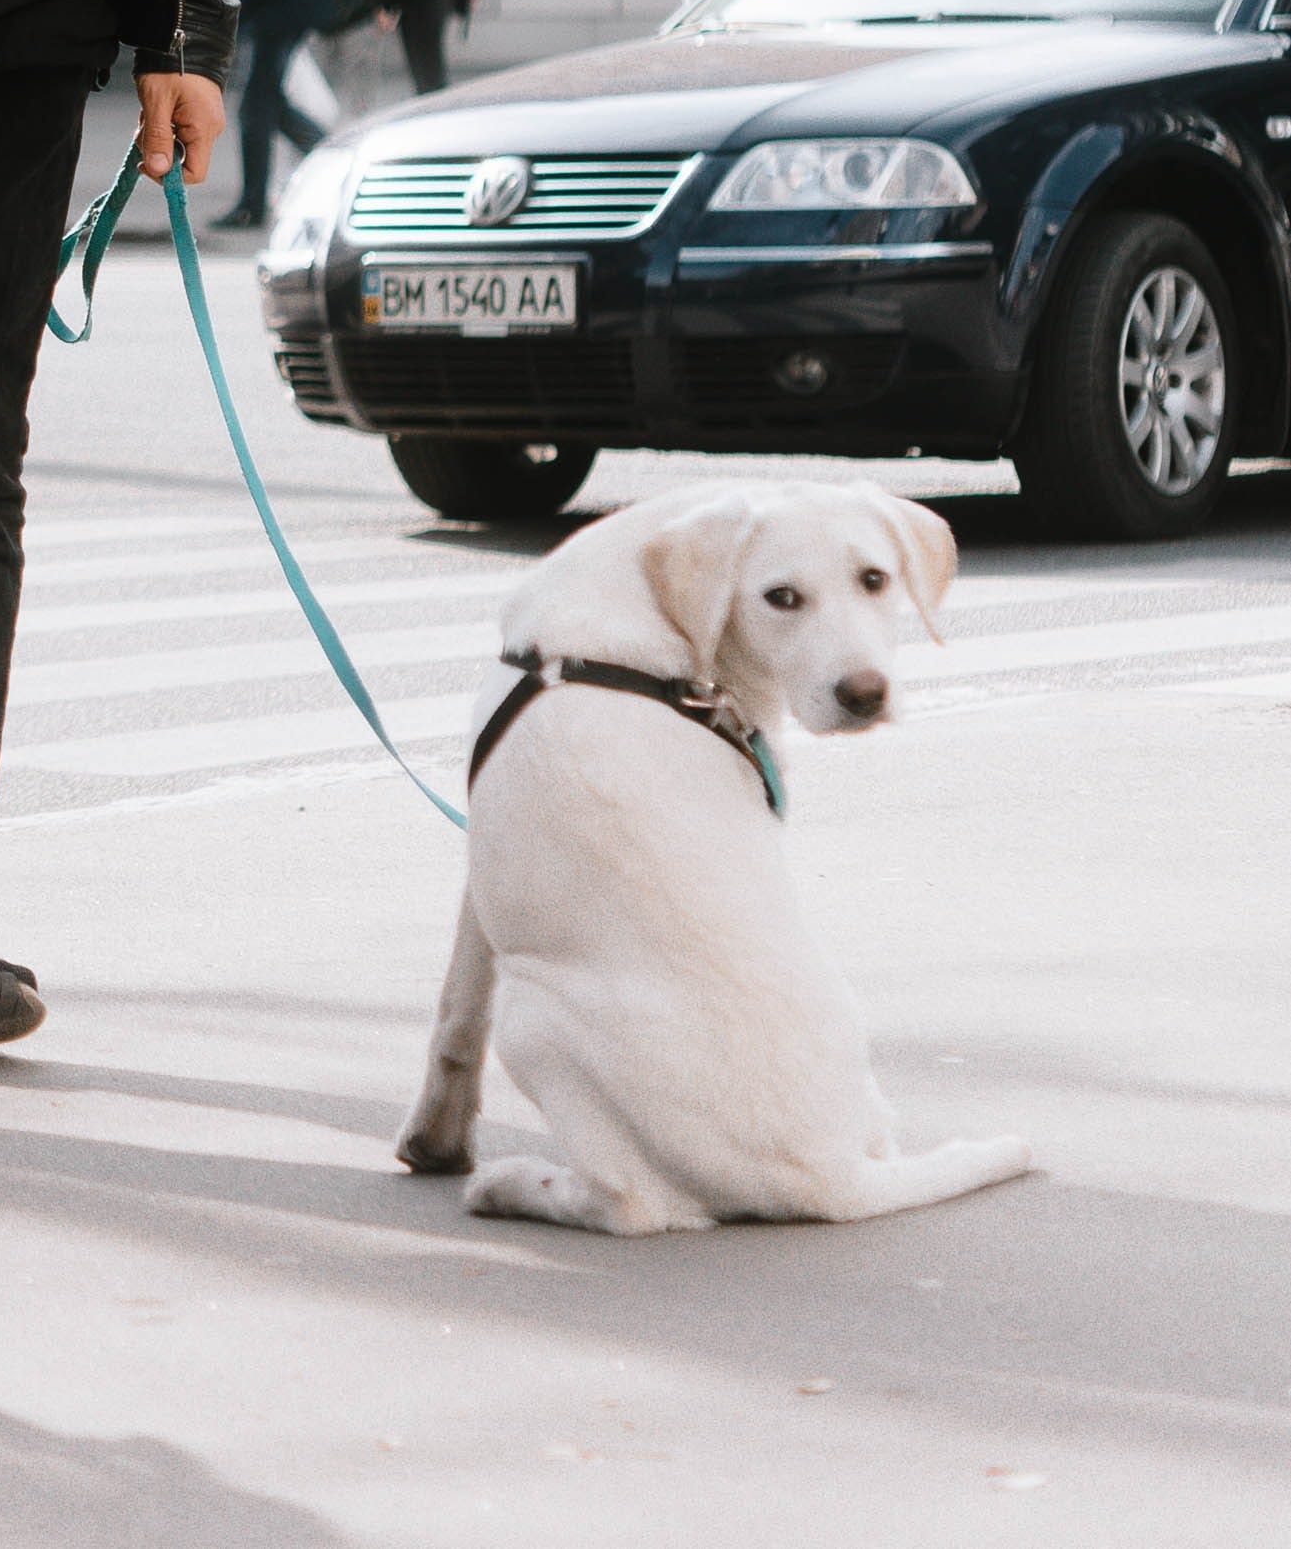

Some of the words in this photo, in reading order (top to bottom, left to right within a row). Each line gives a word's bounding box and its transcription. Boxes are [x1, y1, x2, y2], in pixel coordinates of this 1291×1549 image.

[383, 276, 425, 317] BM
[437, 276, 507, 316] 1540
[518, 275, 565, 317] AA
